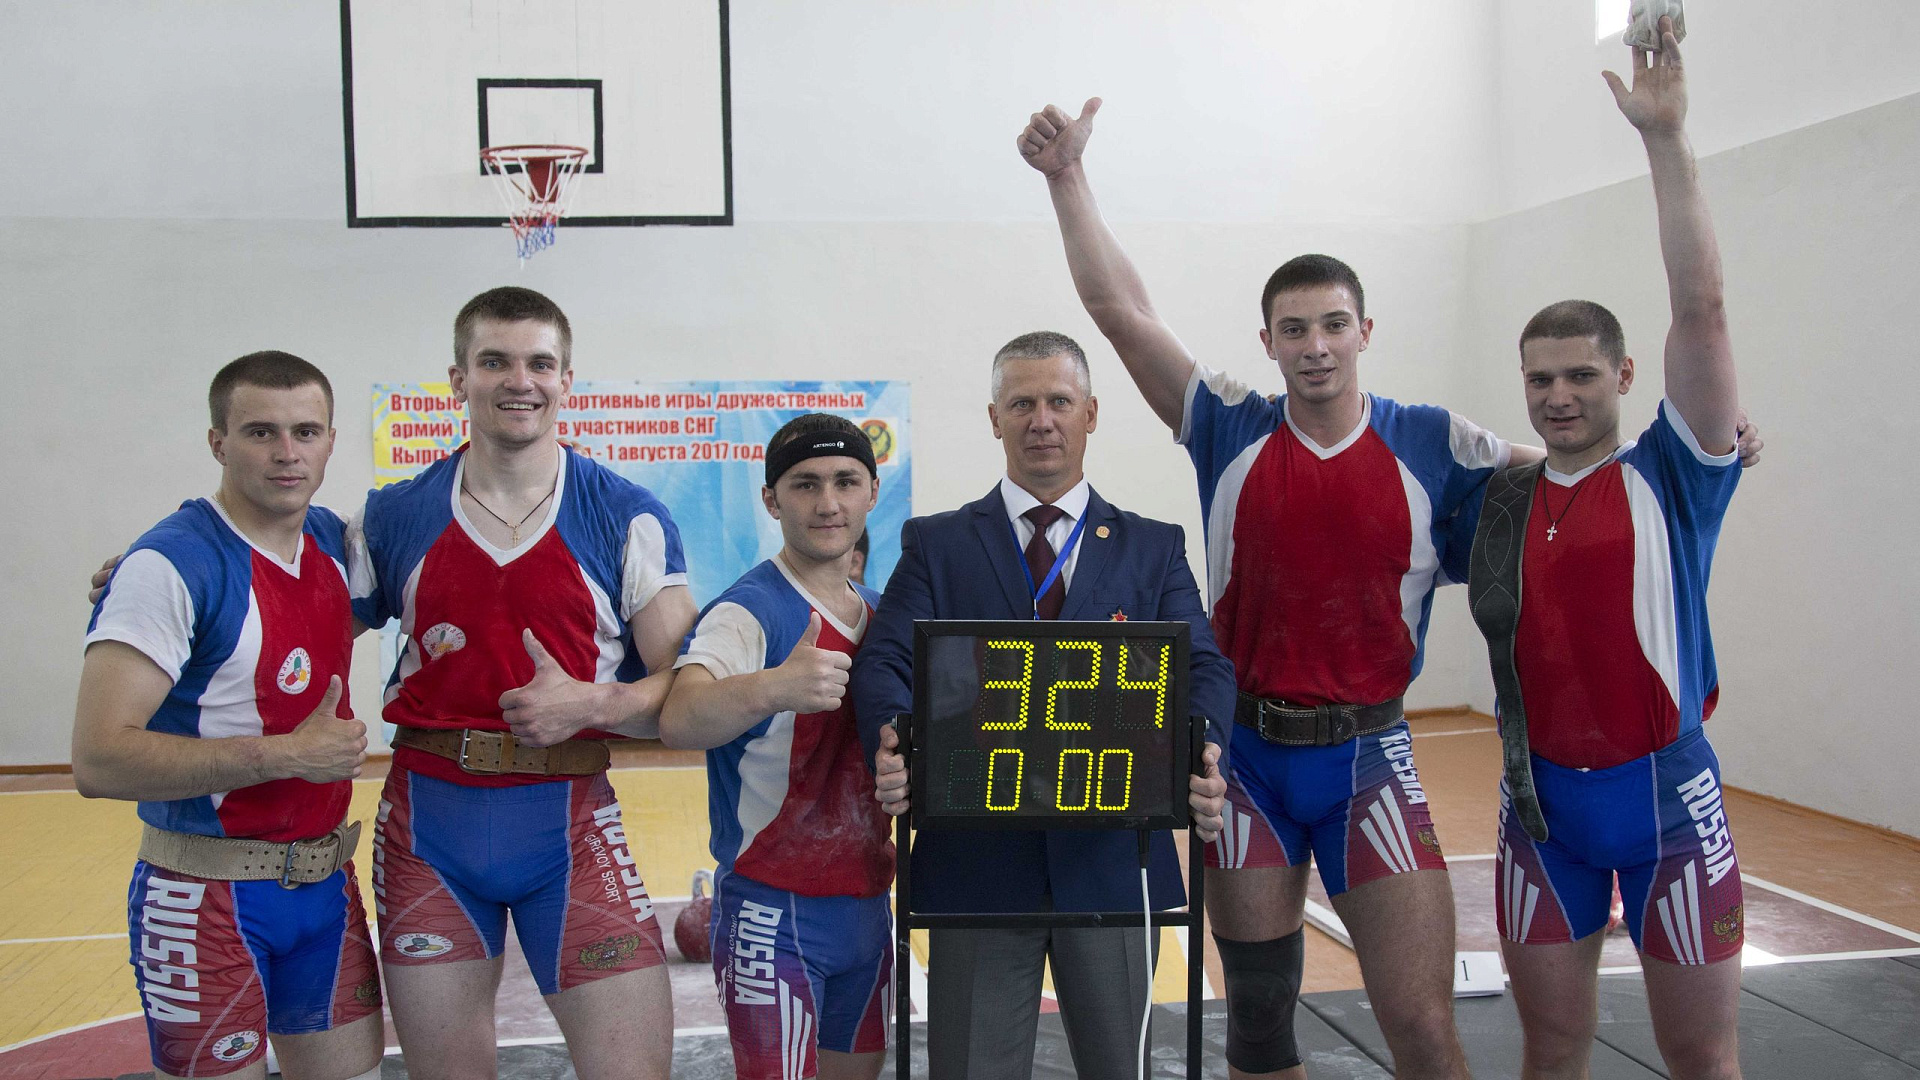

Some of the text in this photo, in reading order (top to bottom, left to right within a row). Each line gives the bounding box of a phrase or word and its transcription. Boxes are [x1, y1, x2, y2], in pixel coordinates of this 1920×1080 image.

[391, 393, 864, 412] Вторые ортивные игры дружественных
[391, 419, 453, 439] армий
[573, 420, 679, 437] участников
[684, 417, 716, 434] СНГ
[606, 444, 614, 461] 1
[618, 446, 687, 462] августа
[691, 442, 729, 460] 2017
[981, 640, 1170, 731] 324
[1379, 731, 1428, 805] RUSSIA
[592, 802, 656, 923] RUSSIA
[1676, 767, 1736, 887] RUSSIA
[584, 833, 621, 903] GIREVOY SPORT
[139, 875, 206, 1023] RUSSIA
[734, 900, 783, 1005] RUSSIA
[1460, 960, 1471, 981] 1
